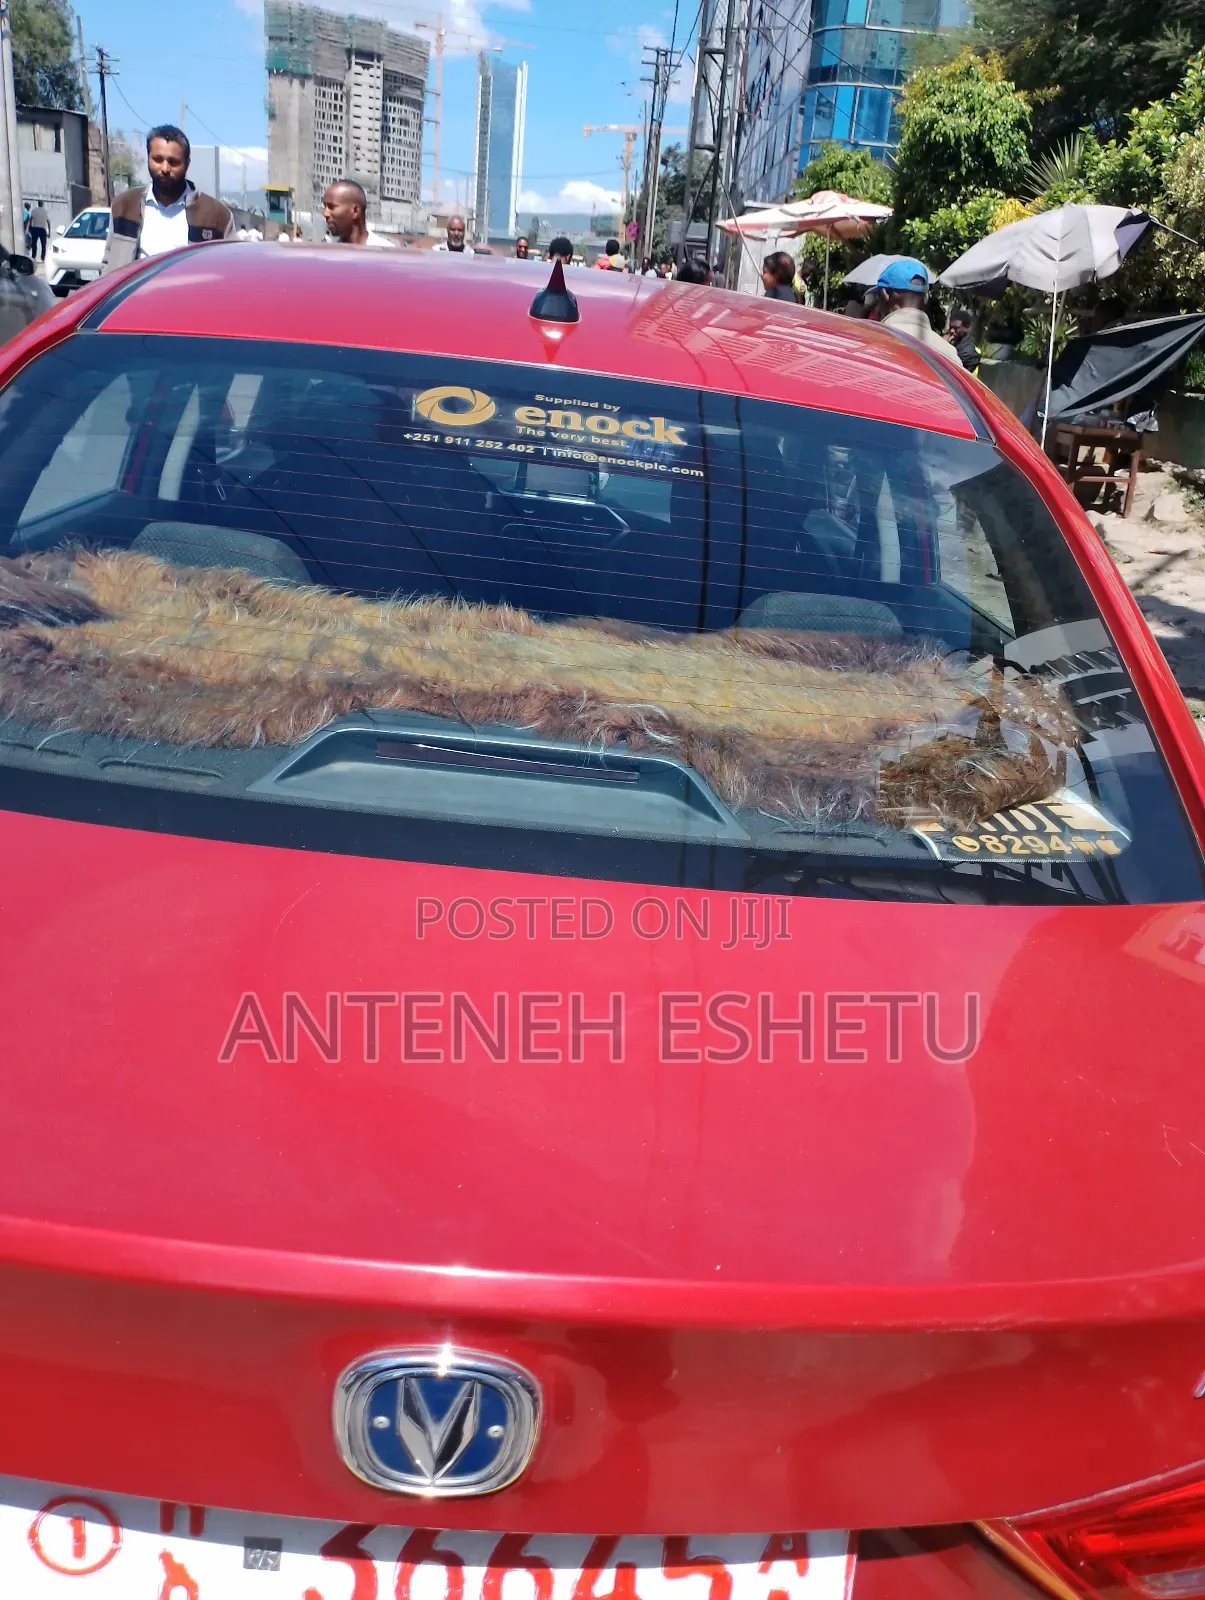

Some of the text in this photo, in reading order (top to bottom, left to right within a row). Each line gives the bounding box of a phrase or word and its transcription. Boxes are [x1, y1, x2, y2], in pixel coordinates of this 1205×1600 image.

[534, 394, 621, 413] Supplied by
[514, 405, 688, 446] enock
[516, 425, 629, 448] The very best.
[403, 433, 439, 443] +251
[444, 437, 470, 446] 911
[475, 439, 504, 450] 252
[507, 443, 535, 454] 402
[553, 447, 704, 477] info@enockplc.com
[978, 834, 1073, 855] 8294
